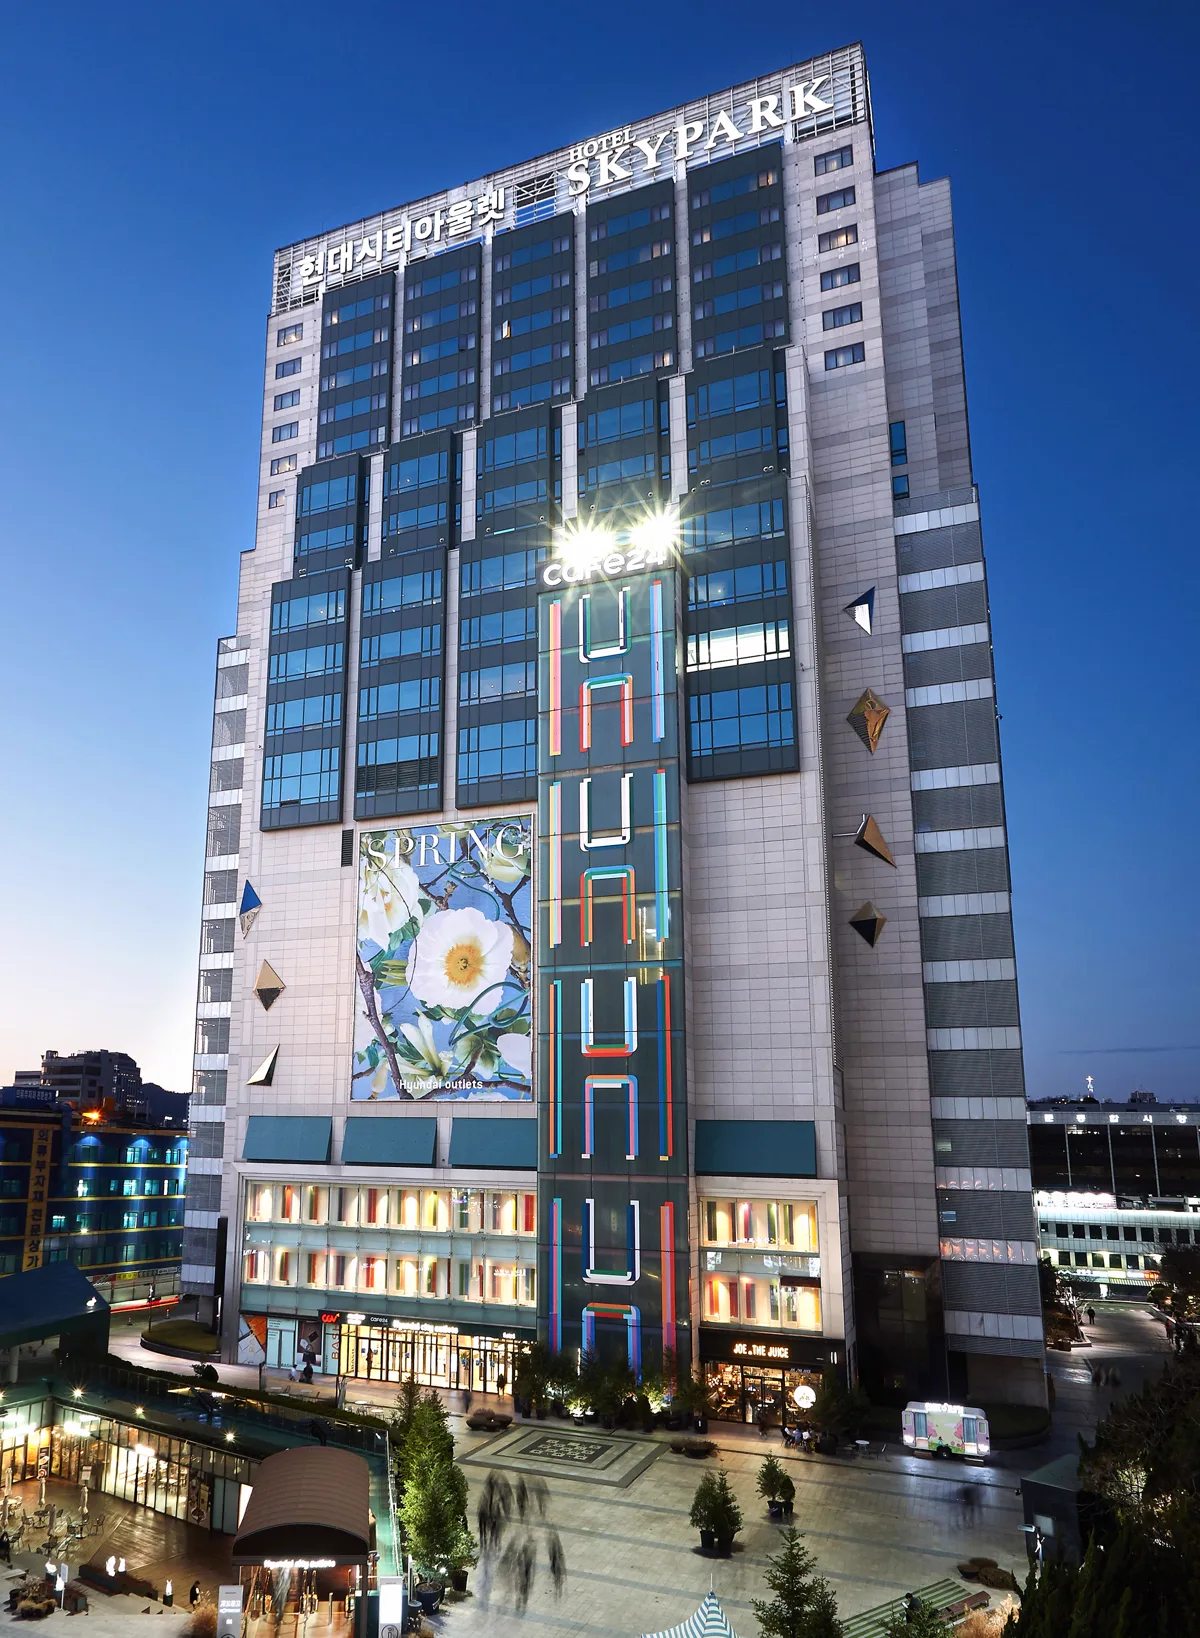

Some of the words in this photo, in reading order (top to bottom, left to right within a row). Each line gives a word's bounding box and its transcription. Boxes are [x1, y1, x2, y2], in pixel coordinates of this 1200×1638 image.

[566, 74, 836, 196] SKYPARK
[568, 126, 636, 163] HOTEL
[298, 188, 505, 286] 현대시티아울렛
[542, 549, 668, 586] cafe24
[366, 824, 525, 873] SPRING
[399, 1079, 442, 1091] Hyundai
[445, 1079, 483, 1090] outlets
[321, 1313, 338, 1323] CGV
[734, 1343, 747, 1355] JOE
[752, 1344, 766, 1356] THE
[767, 1346, 789, 1359] JUICE
